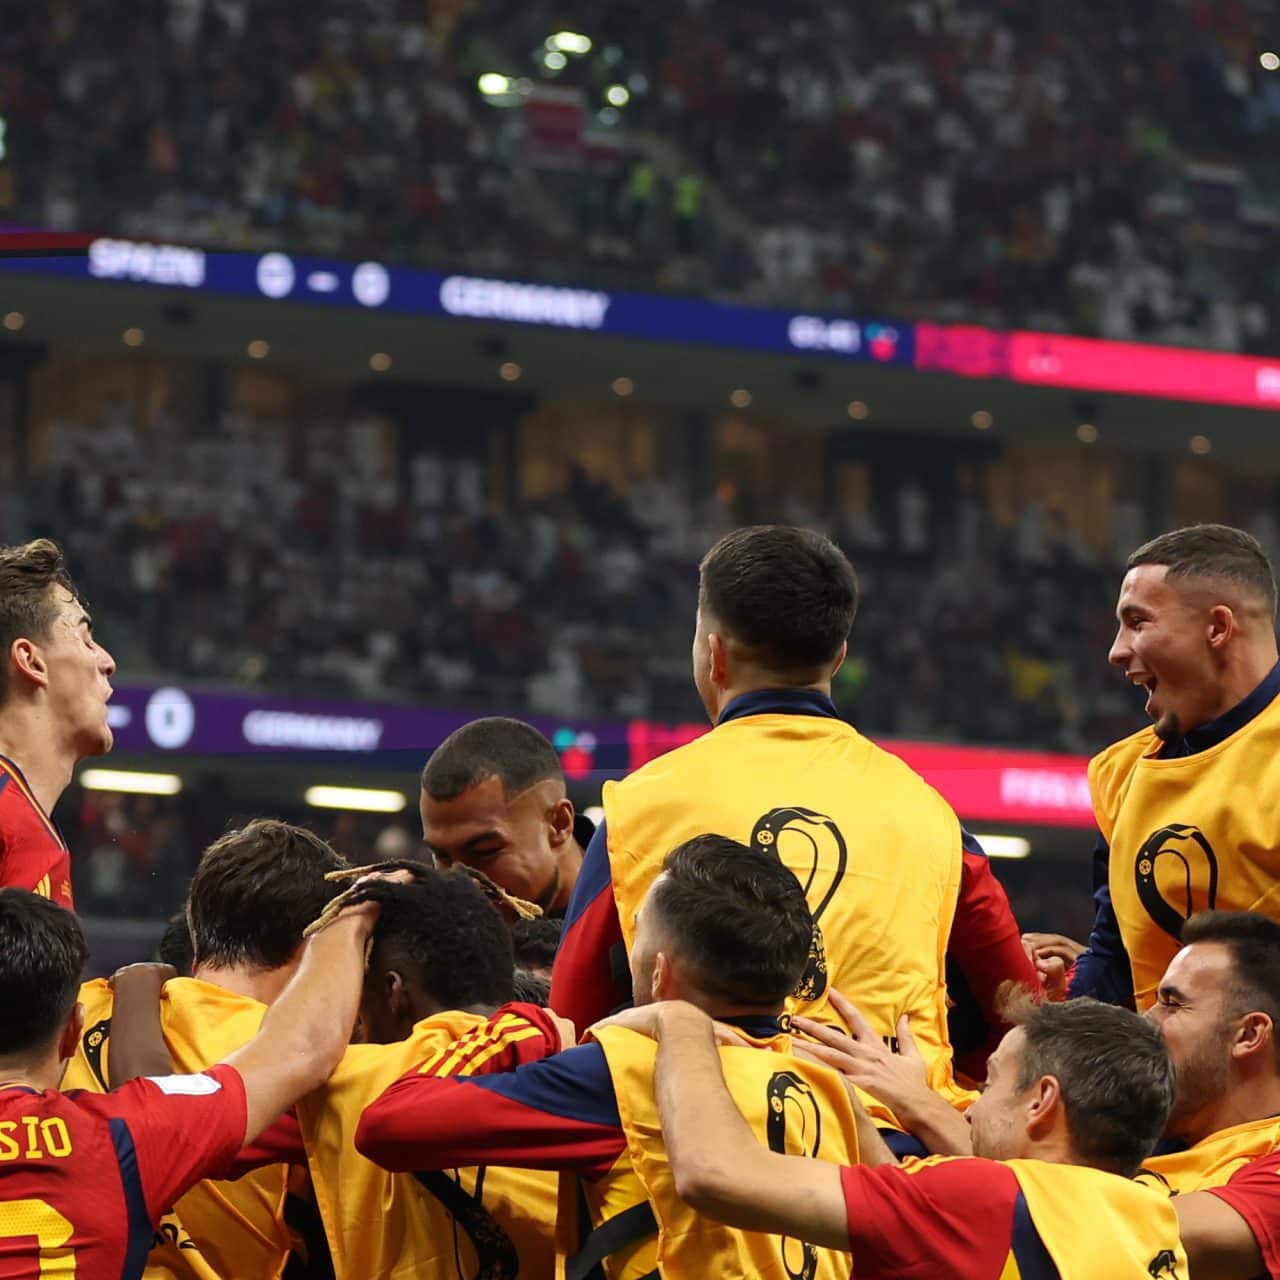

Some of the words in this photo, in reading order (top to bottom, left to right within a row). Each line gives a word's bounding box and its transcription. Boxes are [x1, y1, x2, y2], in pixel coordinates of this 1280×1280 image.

[88, 238, 206, 288] SPAIN
[256, 251, 295, 299] 0
[352, 260, 390, 307] 0
[439, 275, 611, 330] GERMANY
[145, 686, 194, 750] 0
[243, 709, 382, 752] GERMANY
